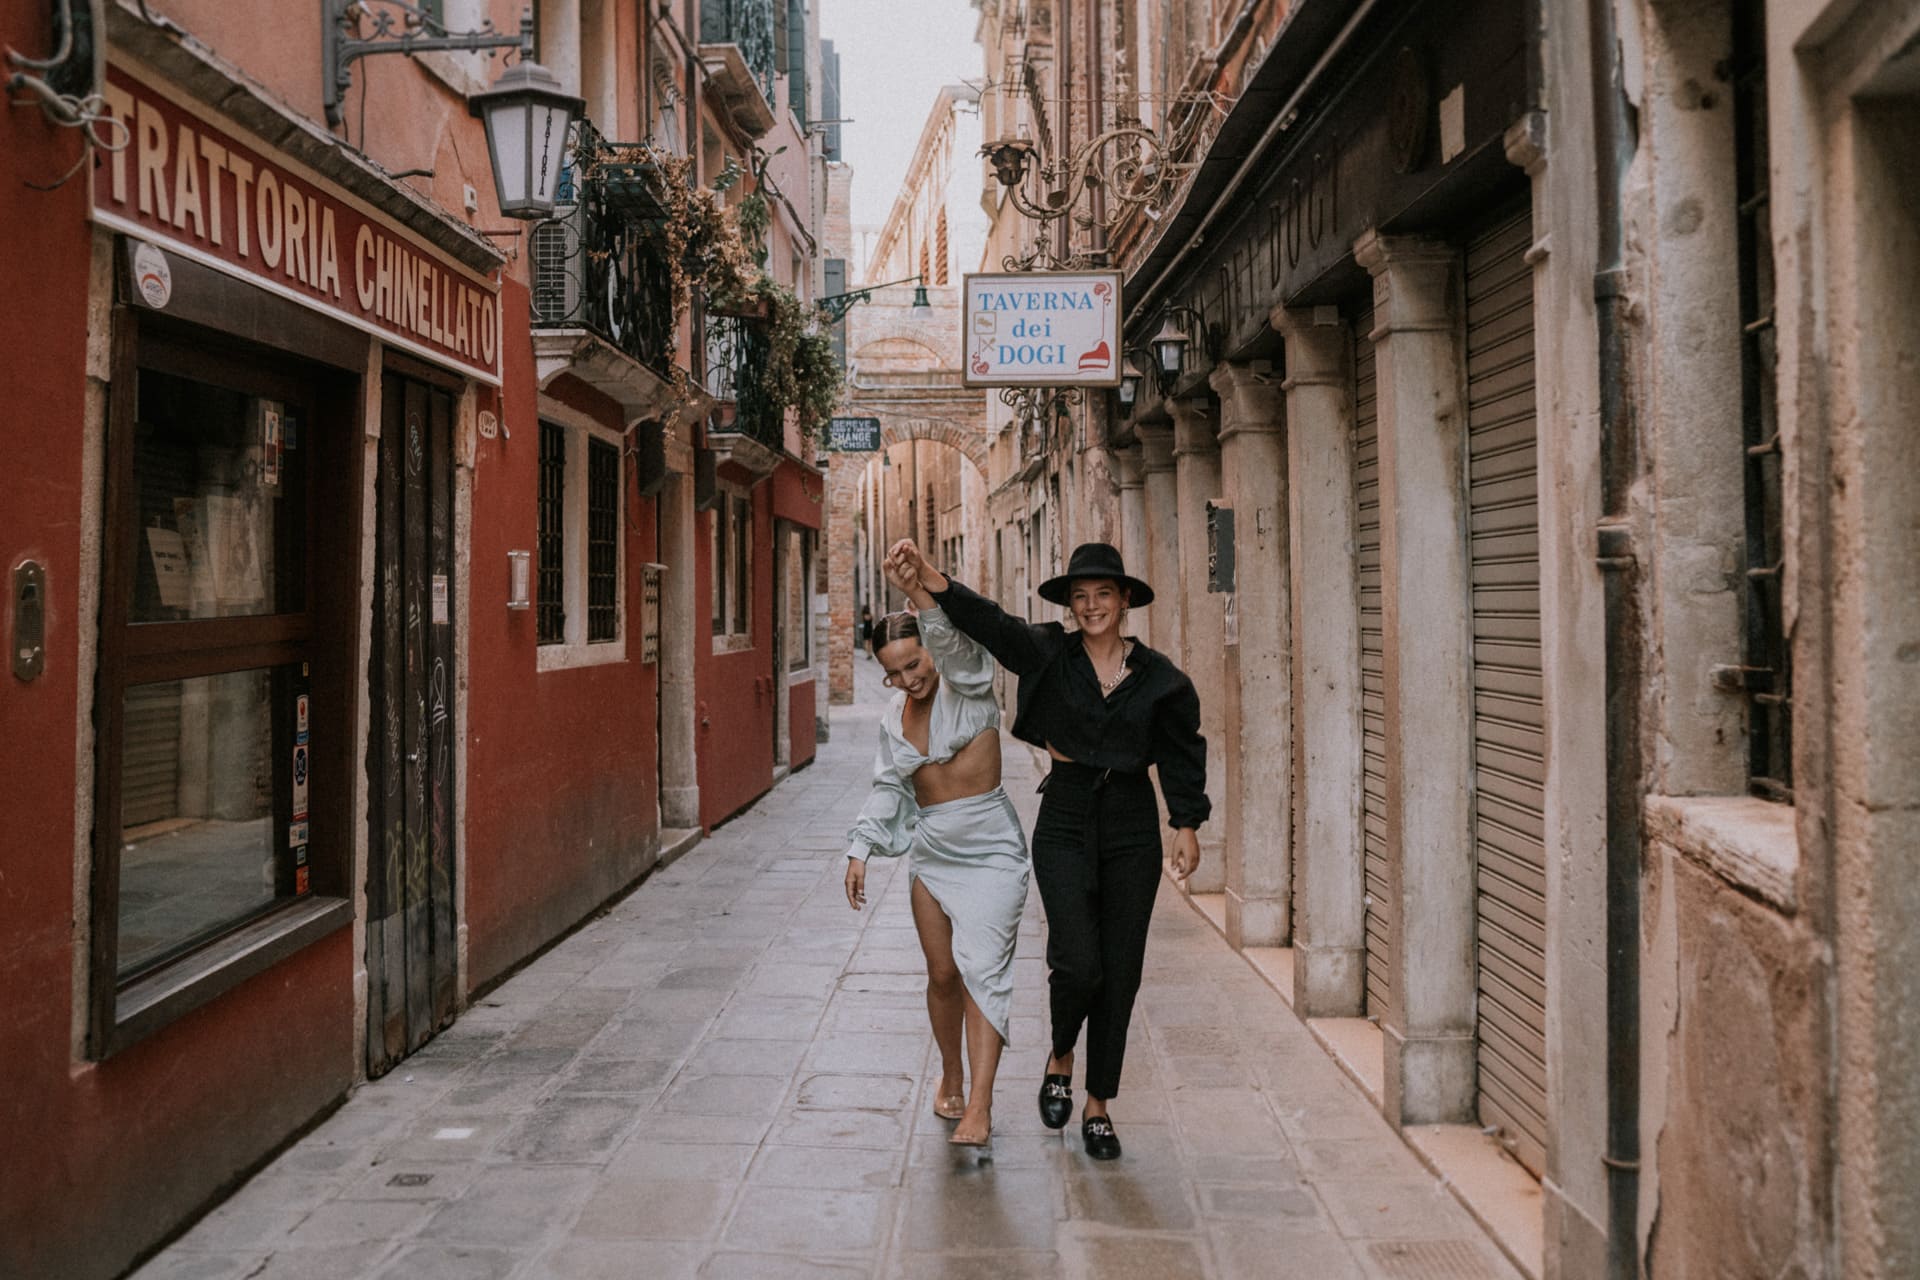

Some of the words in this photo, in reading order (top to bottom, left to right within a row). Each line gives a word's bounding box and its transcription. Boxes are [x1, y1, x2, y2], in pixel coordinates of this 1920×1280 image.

[105, 80, 341, 298] TRATTORIA
[355, 224, 495, 365] CHINELLATO
[978, 291, 1094, 311] TAVERNA
[1012, 318, 1052, 338] dei
[997, 344, 1066, 365] DOGI
[832, 432, 871, 441] CHANGE
